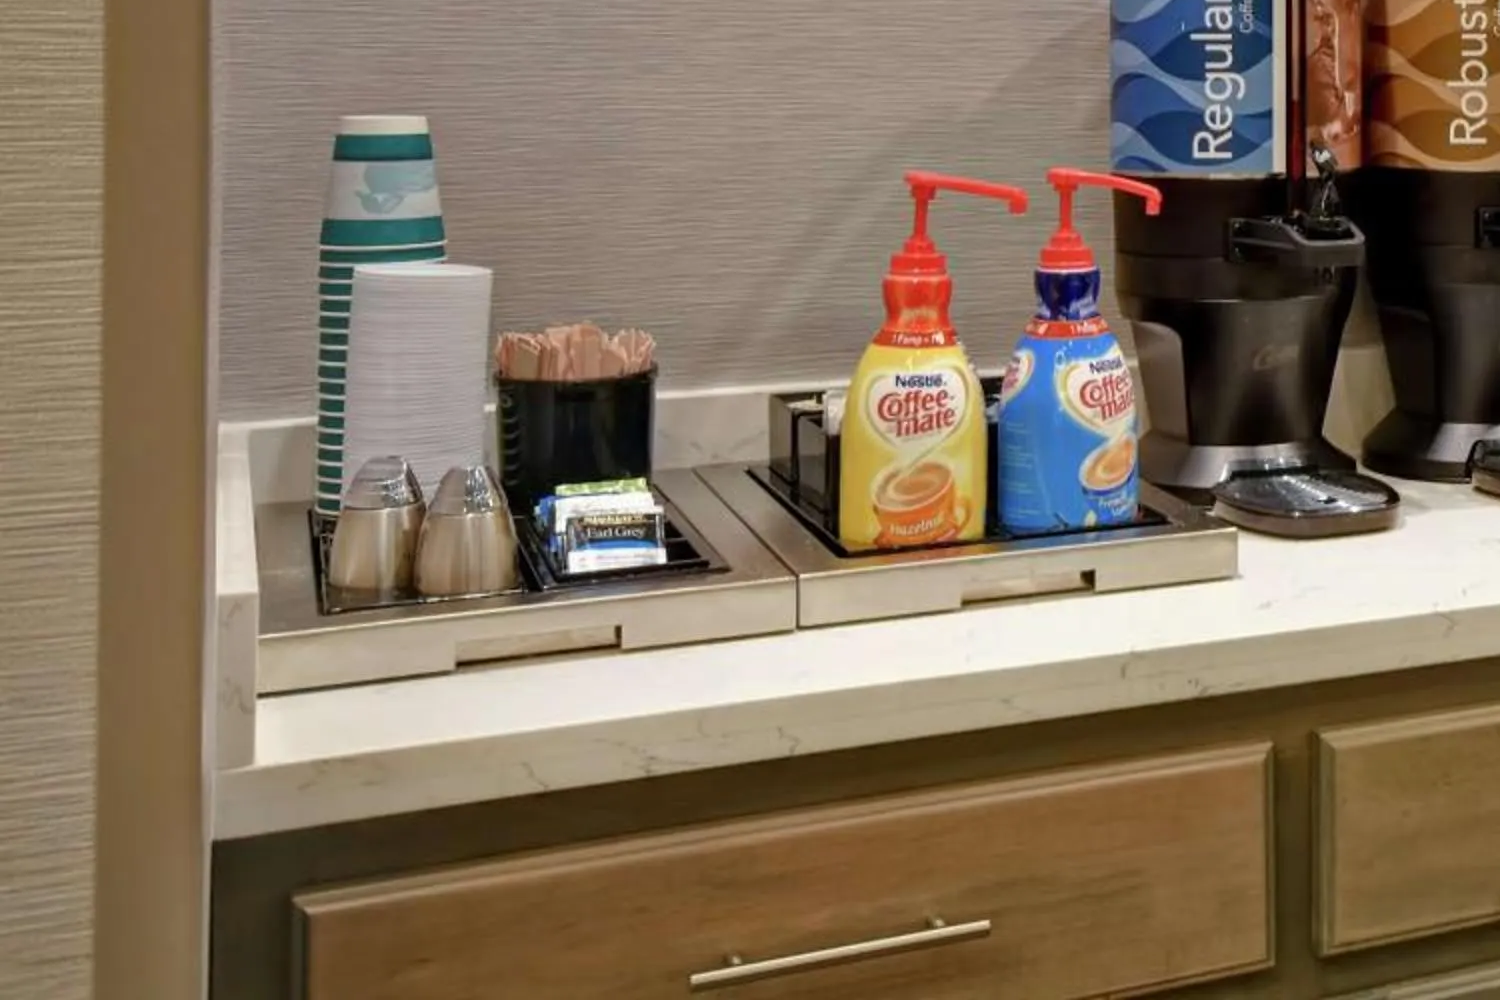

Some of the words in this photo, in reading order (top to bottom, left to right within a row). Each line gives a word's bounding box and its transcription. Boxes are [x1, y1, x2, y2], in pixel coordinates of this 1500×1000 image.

[895, 408, 955, 437] mate
[587, 527, 612, 538] Earl
[615, 526, 645, 539] Grey
